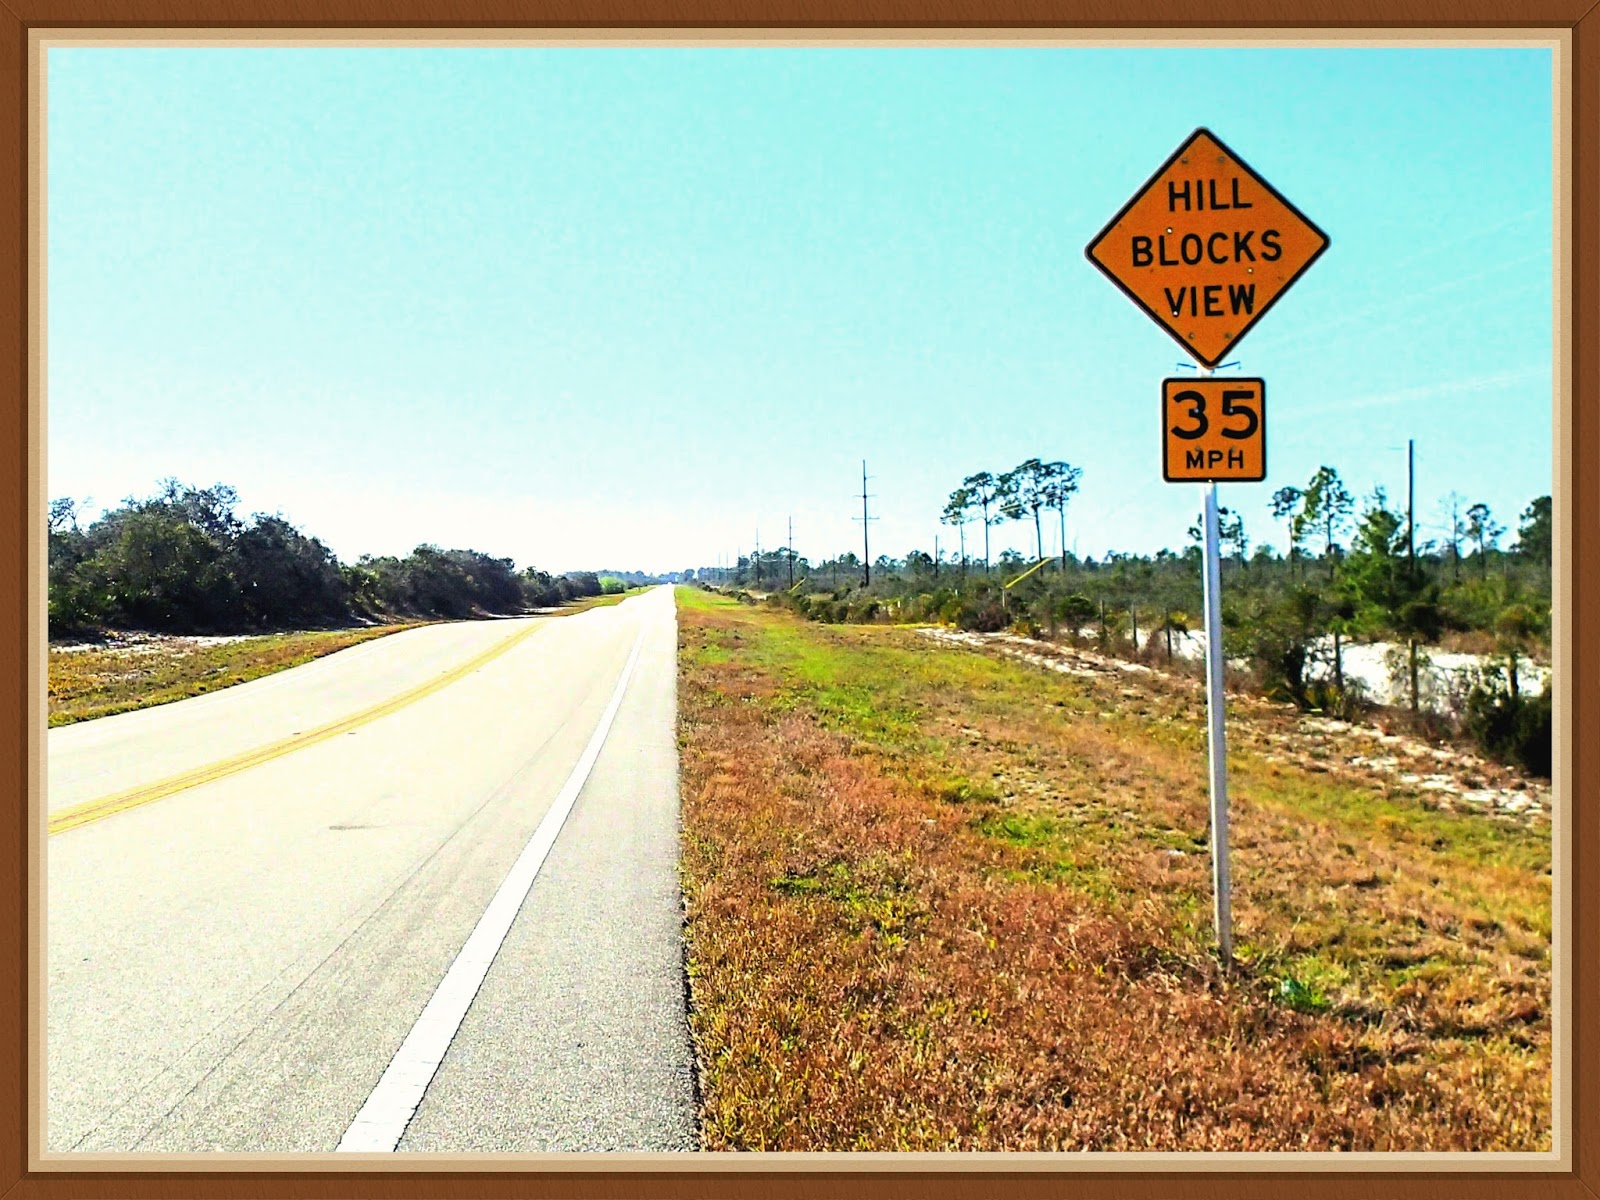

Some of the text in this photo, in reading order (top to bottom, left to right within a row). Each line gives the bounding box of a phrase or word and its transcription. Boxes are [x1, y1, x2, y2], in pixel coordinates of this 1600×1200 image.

[1168, 178, 1253, 212] HILL
[1131, 229, 1283, 267] BLOCKS
[1163, 284, 1256, 318] VIEW
[1170, 389, 1259, 441] 35
[1185, 449, 1245, 470] MPH
